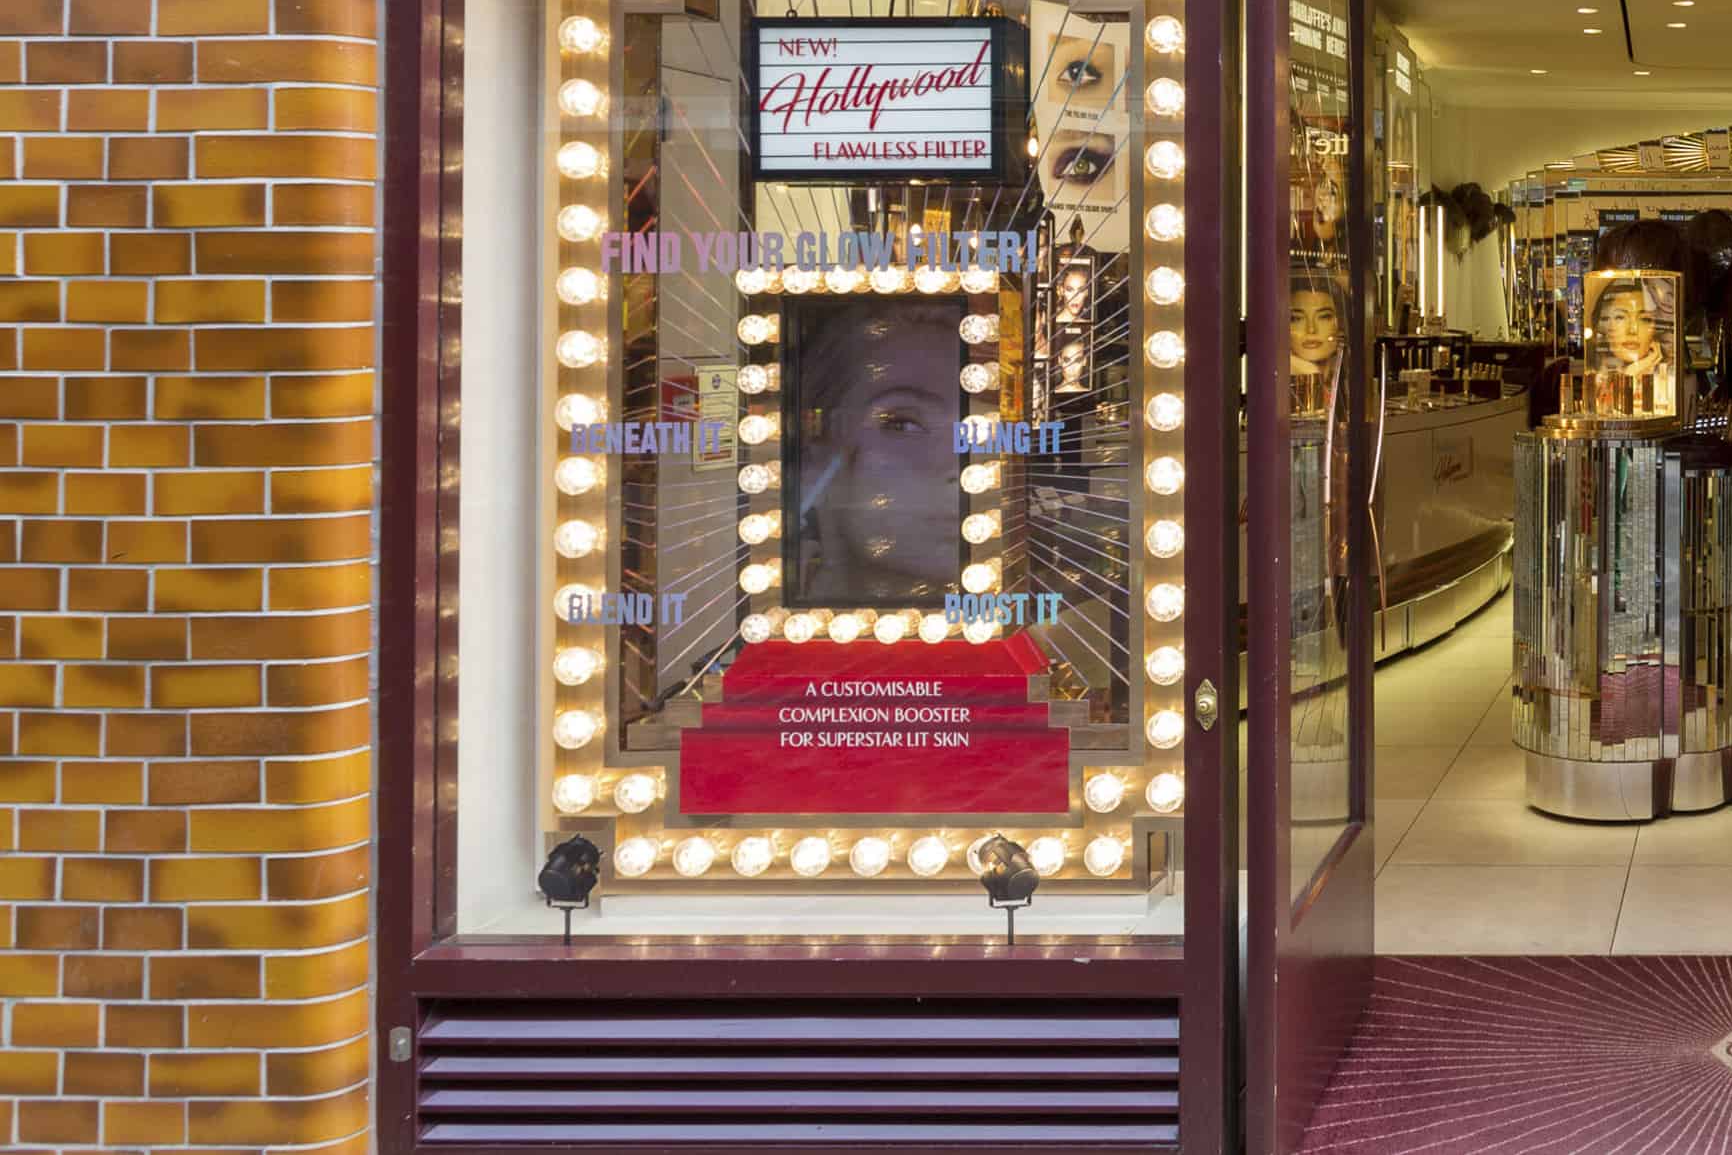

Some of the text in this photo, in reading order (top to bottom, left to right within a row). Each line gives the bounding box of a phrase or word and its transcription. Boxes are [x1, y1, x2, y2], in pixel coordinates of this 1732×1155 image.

[778, 37, 837, 57] NEW!
[760, 40, 990, 134] Hollywood
[813, 140, 986, 159] FLAWLESS FILTER
[602, 231, 1037, 273] FIND YOUR GLOW FILTER!
[571, 422, 690, 454] BENEATH
[699, 422, 725, 454] IT
[953, 422, 1065, 454] BLING IT
[568, 593, 688, 624] BLEND IT
[945, 592, 1063, 625] BOOST IT
[805, 681, 943, 697] A CUSTOMISABLE
[778, 707, 970, 723] COMPLEXION BOOSTER
[780, 732, 970, 747] FOR SUPERSTAR LIT SKIN
